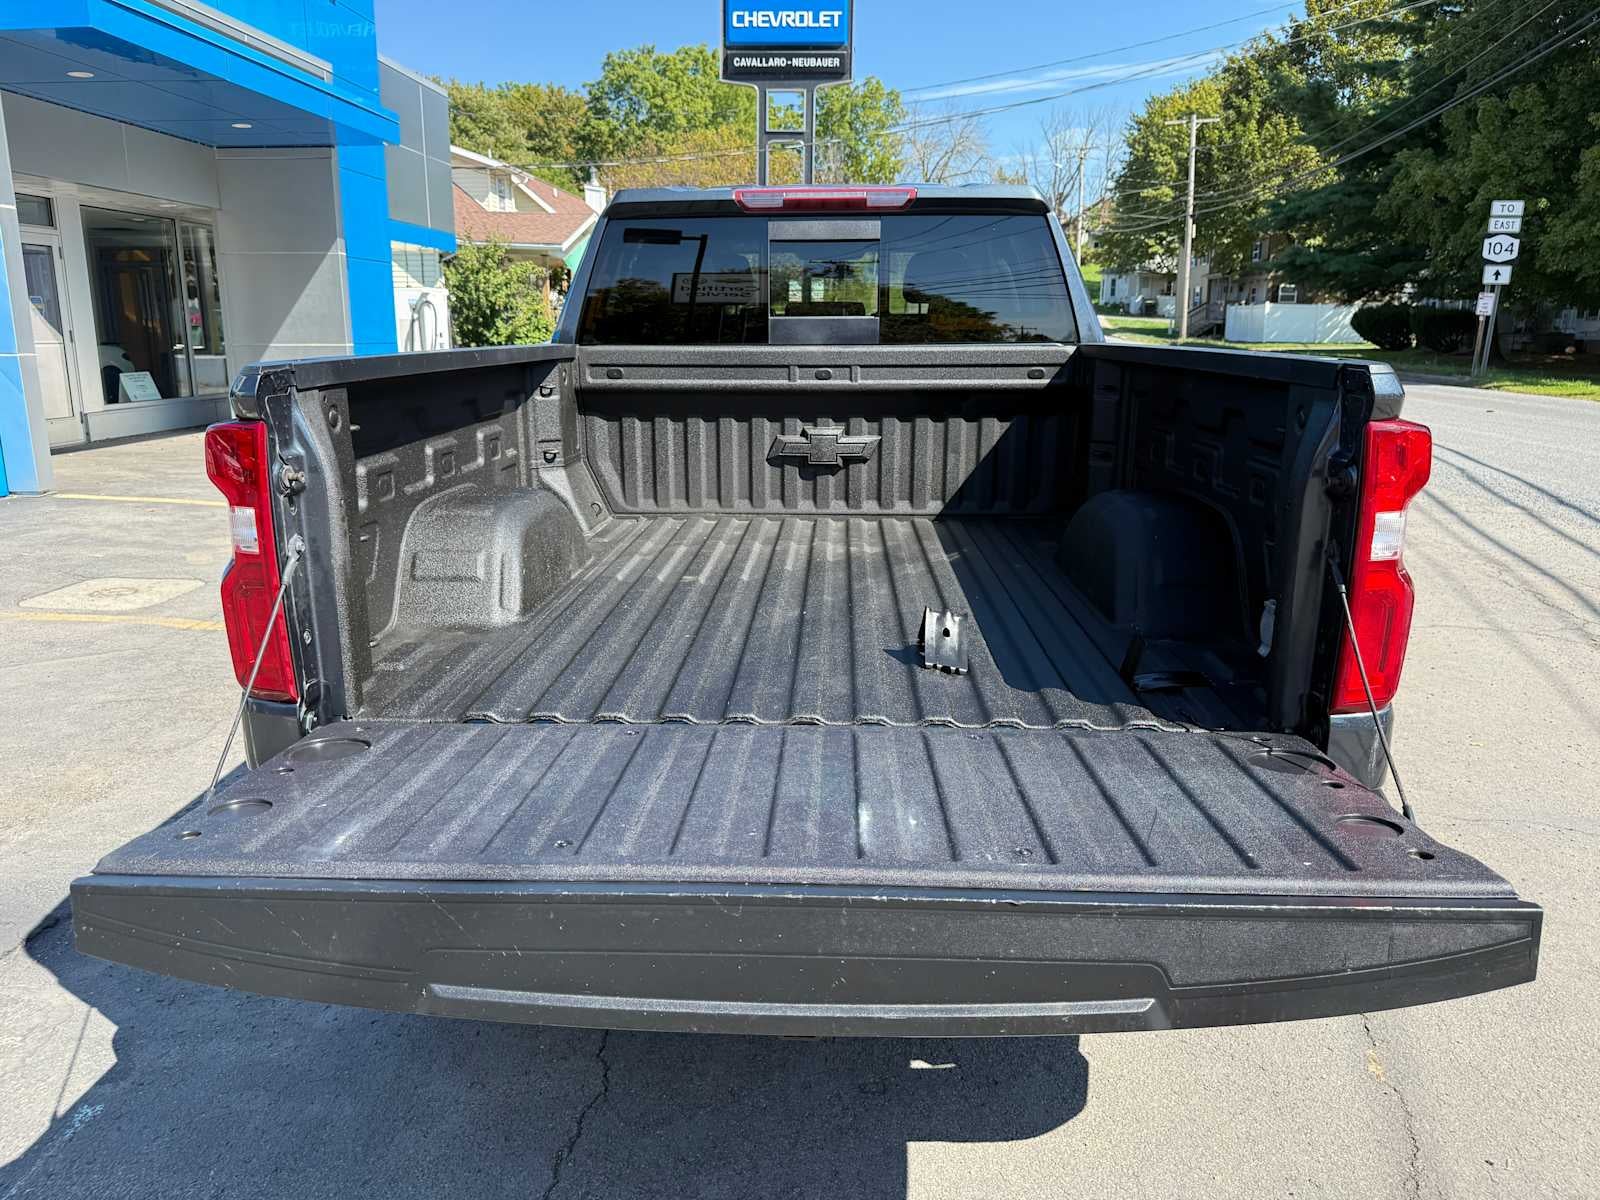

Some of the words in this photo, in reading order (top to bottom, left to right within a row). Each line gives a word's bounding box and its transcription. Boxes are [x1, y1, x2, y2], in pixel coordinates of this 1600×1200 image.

[732, 11, 842, 27] CHEVROLET
[1500, 204, 1515, 213] TO
[1493, 221, 1516, 230] EAST
[1487, 242, 1515, 255] 104
